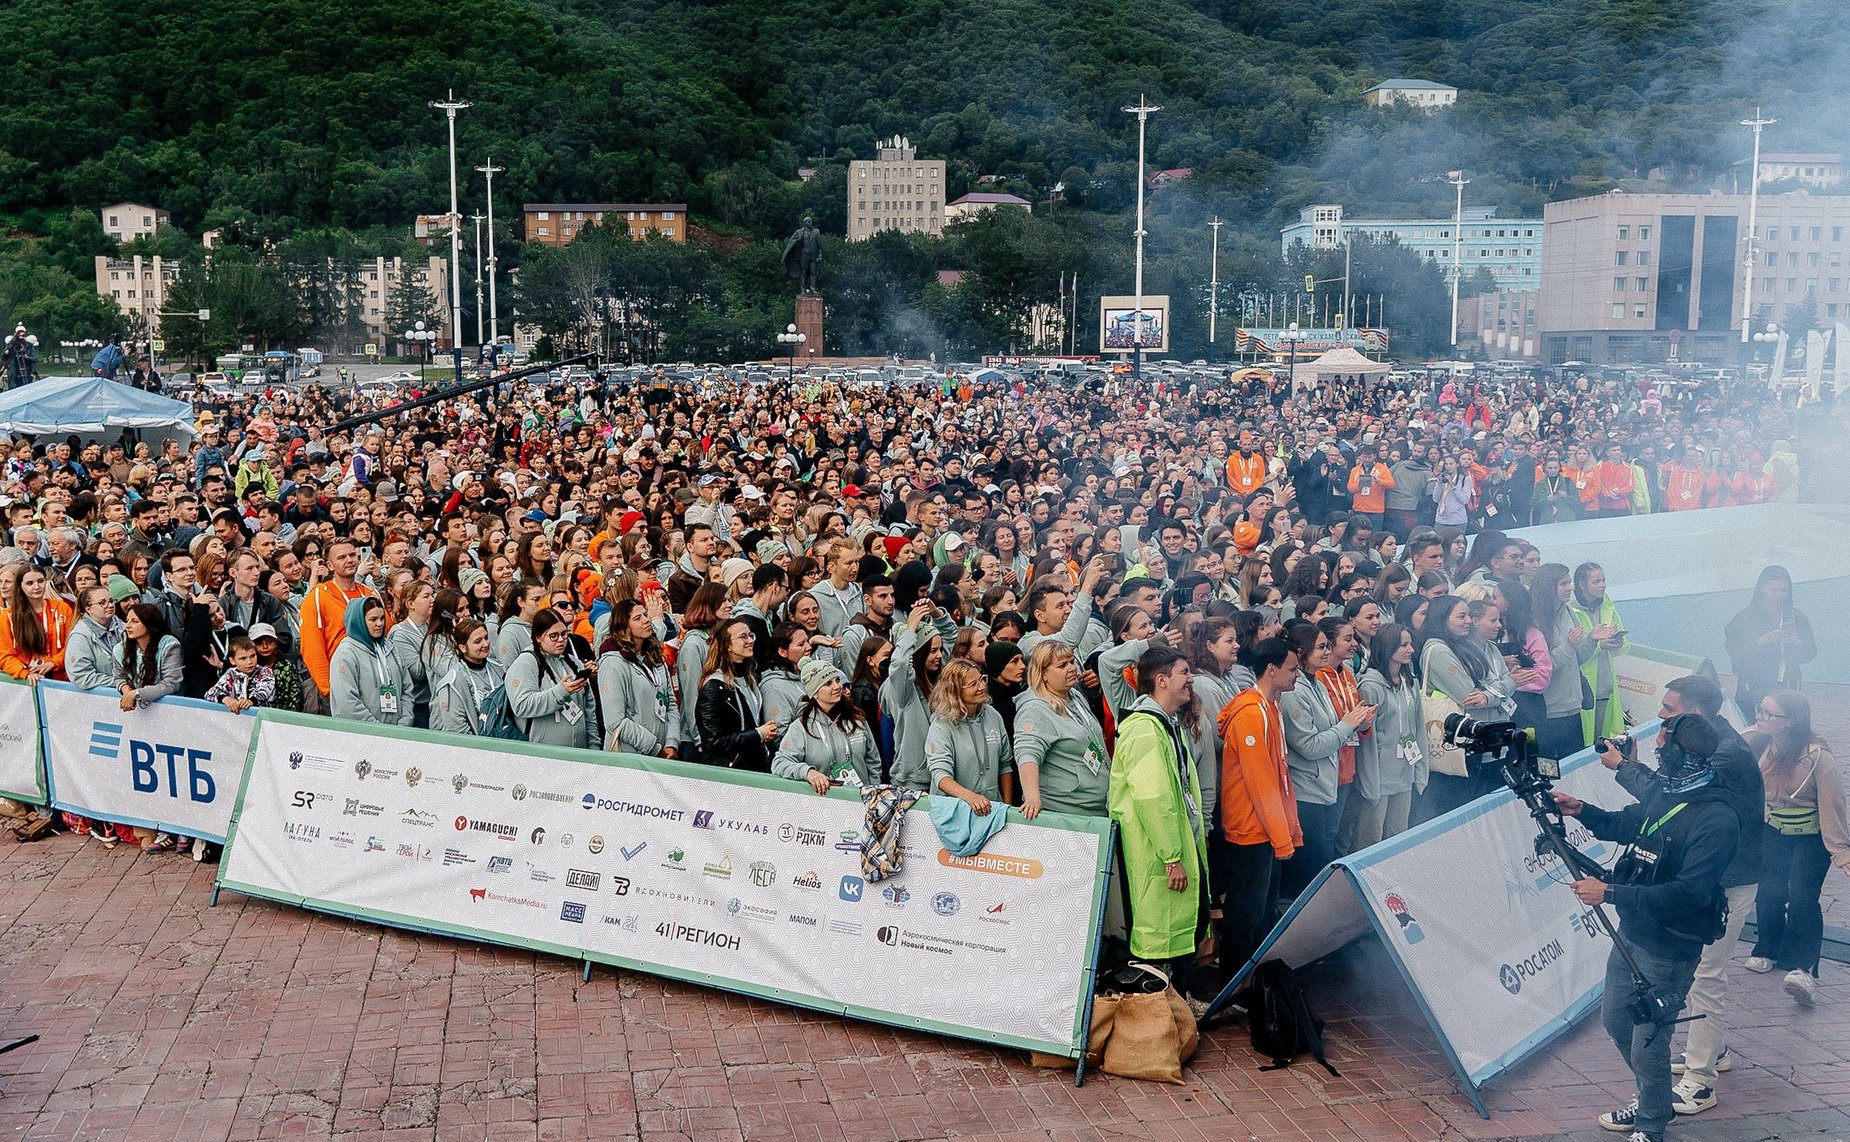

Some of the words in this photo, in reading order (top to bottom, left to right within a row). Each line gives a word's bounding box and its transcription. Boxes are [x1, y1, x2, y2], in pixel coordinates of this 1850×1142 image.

[129, 738, 216, 804] ВТБ
[290, 790, 315, 809] SR
[597, 799, 684, 822] РОСГИДРОМЕТ
[401, 817, 434, 828] СПЕЦТРАНС
[469, 819, 518, 836] YAMAGUCHI
[718, 819, 769, 835] УКУЛАБ
[796, 832, 826, 847] РДКМ
[948, 854, 1031, 876] #МЫВМЕСТЕ
[569, 870, 599, 889] ДЕЛАЙ!
[748, 868, 777, 887] ЛЕСА
[792, 875, 822, 889] Helios
[487, 892, 548, 909] KamchatkaMedia.ru
[742, 904, 778, 916] ЭКОСОФИЯ
[978, 915, 1011, 926] РОСКОСМОС
[676, 925, 741, 951] РЕГИОН
[902, 929, 964, 946] Аэрокосмическая
[964, 941, 1007, 954] корпорация
[900, 940, 925, 950] Новый
[925, 945, 953, 955] космос
[1516, 938, 1565, 982] РОСАТОМ
